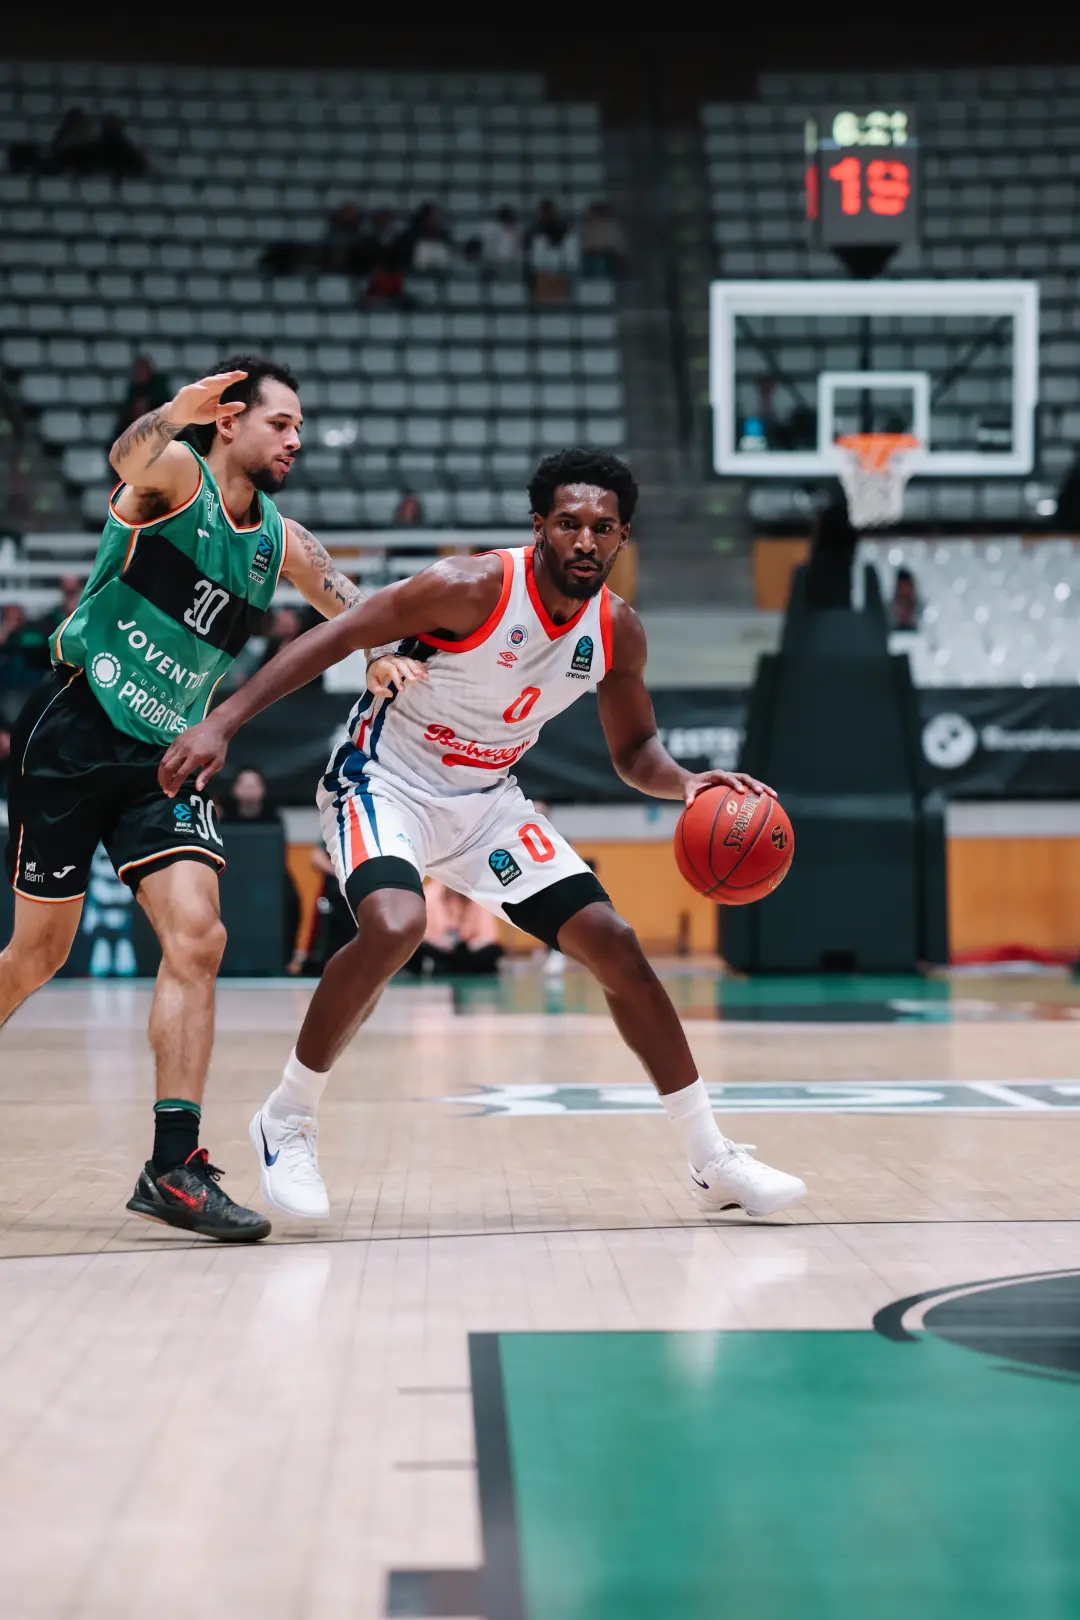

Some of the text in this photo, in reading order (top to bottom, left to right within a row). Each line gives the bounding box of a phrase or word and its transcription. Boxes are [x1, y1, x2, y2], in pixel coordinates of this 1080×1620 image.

[184, 579, 230, 636] 30
[565, 671, 591, 682] oneteam
[118, 680, 188, 734] PROBITAS
[502, 686, 542, 724] 0
[517, 823, 556, 864] 0
